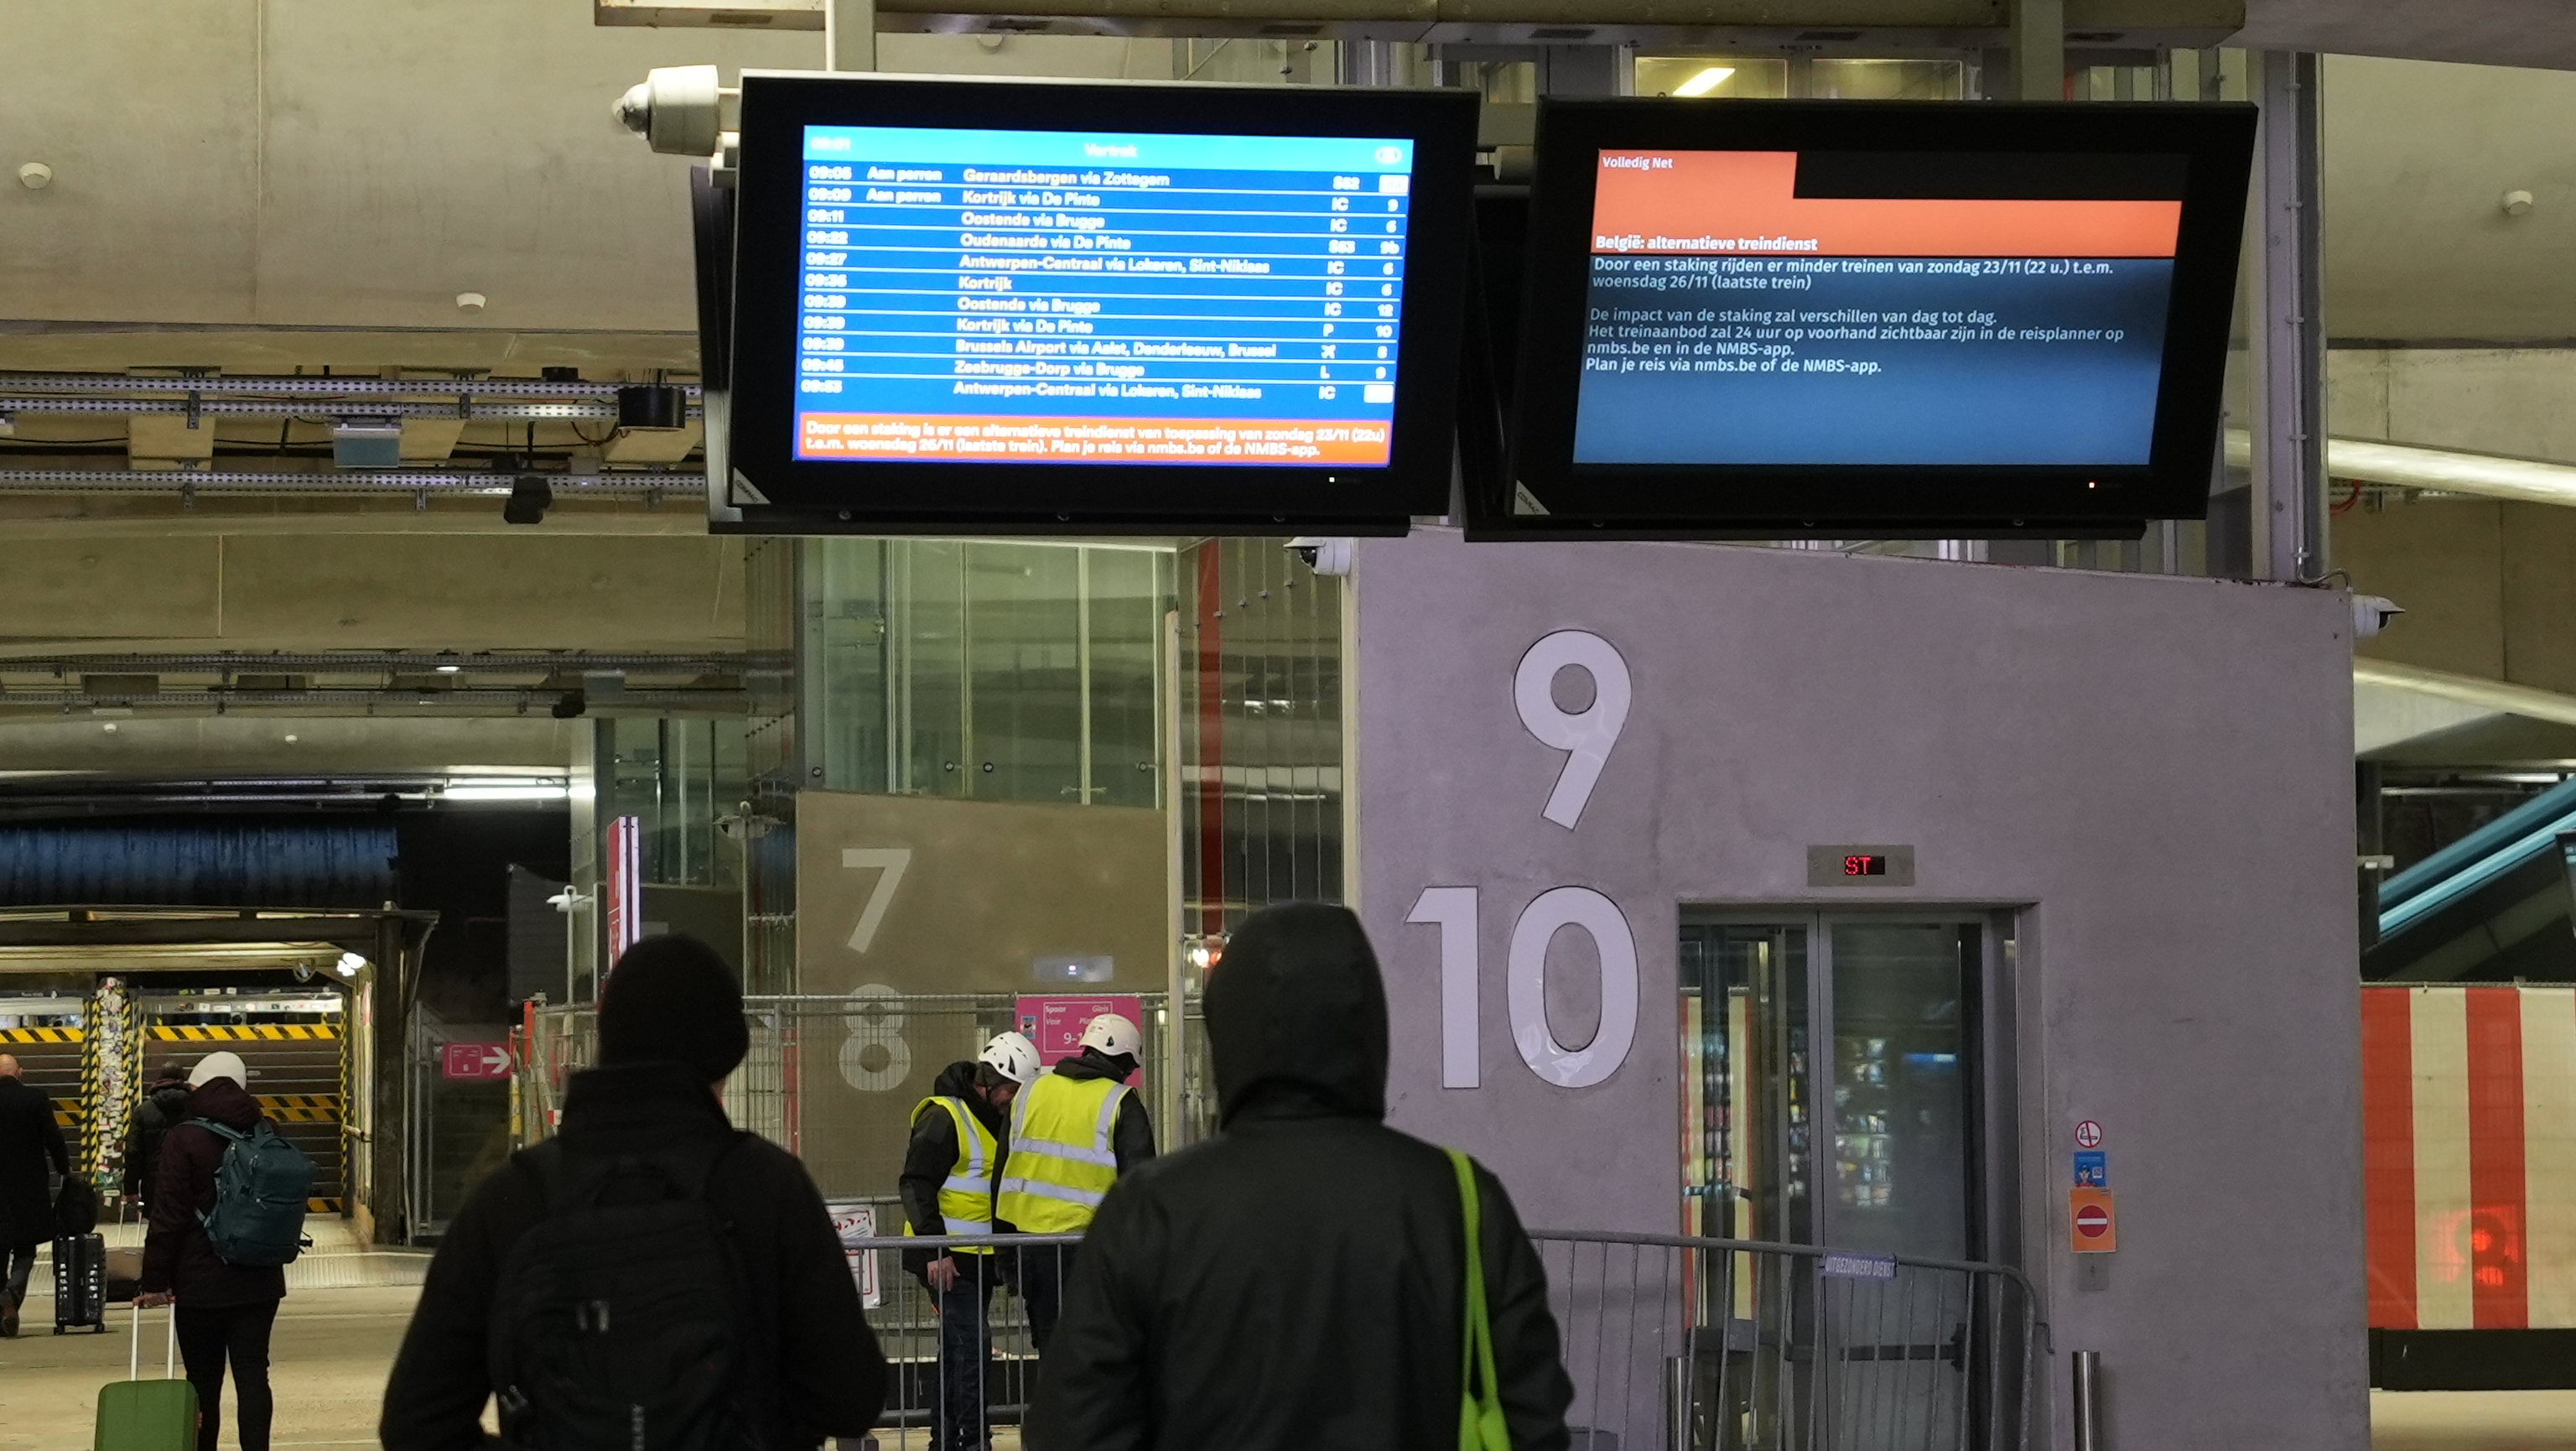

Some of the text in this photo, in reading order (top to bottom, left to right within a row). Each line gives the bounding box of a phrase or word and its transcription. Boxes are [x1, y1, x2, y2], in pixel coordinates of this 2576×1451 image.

[1084, 143, 1138, 158] Vertrek
[1603, 157, 1673, 170] Volledig Net
[868, 167, 895, 179] Aan
[897, 170, 942, 181] perron
[963, 169, 1077, 185] Geraardsbergen
[1081, 171, 1100, 185] via
[1103, 172, 1169, 188] Zottegem
[867, 189, 893, 201] Aan
[896, 192, 941, 203] perron
[963, 190, 1015, 206] Kortrijk
[1020, 192, 1039, 205] via
[1042, 192, 1062, 205] De
[1065, 192, 1099, 205] Pinte
[1332, 198, 1348, 211] IC
[808, 209, 1347, 231] 09:11 Oostende via Brugge IC
[961, 233, 1047, 247] Oudenaarde
[1051, 235, 1070, 248] via
[1073, 236, 1093, 248] De
[1096, 236, 1130, 249] Pinte
[1596, 235, 1818, 251] België: alternatieve treindienst
[959, 255, 1103, 271] Antwerpen-Centraal
[1106, 257, 1125, 270] via
[1129, 258, 1186, 273] Lokeren,
[1190, 258, 1270, 273] Sint-Niklaas
[1327, 261, 1344, 274] IC
[1595, 257, 2113, 276] Door een staking rijden er minder treinen van zondag 23/11 (22 u.) t.e.m.
[959, 277, 1343, 295] Kortrijk IC
[1593, 274, 1811, 290] woensdag 26/11 (laatste trein)
[958, 297, 1393, 316] Oostende via Brugge IC 12
[1591, 307, 1997, 326] De impact van de staking zal verschillen van dag tot dag.
[957, 319, 1392, 337] Kortrijk via De Pinte P 10
[1589, 324, 2124, 342] Het treinaanbod zal 24 uur op voorhand zichtbaar zijn in de reisplanner op
[956, 340, 1276, 357] Brussels Airport via Aalst, Denderleeuw, Brussel
[1587, 341, 1794, 358] nmbs.be en in de NMBS-app.
[954, 361, 1330, 378] Zeebrugge-Dorp via Brugge L
[1586, 357, 1882, 375] Plan je reis via nmbs.be of de NMBS-app.
[953, 382, 1335, 399] Antwerpen-Centraal via Lokeren, Sint-Niklaas IC
[807, 420, 1384, 443] Door een staking is er een alternatieve treindienst van toepassing van zondag 23/11 (22u)
[806, 438, 1320, 457] t.e.m. woensdag 26/11 (laatste trein). Plan je reis via nmbs.be of de NMBS-app.
[1513, 629, 1633, 830] 9
[1845, 856, 1872, 875] ST
[842, 849, 911, 954] 7
[1405, 886, 1639, 1090] 10
[839, 983, 911, 1091] 8
